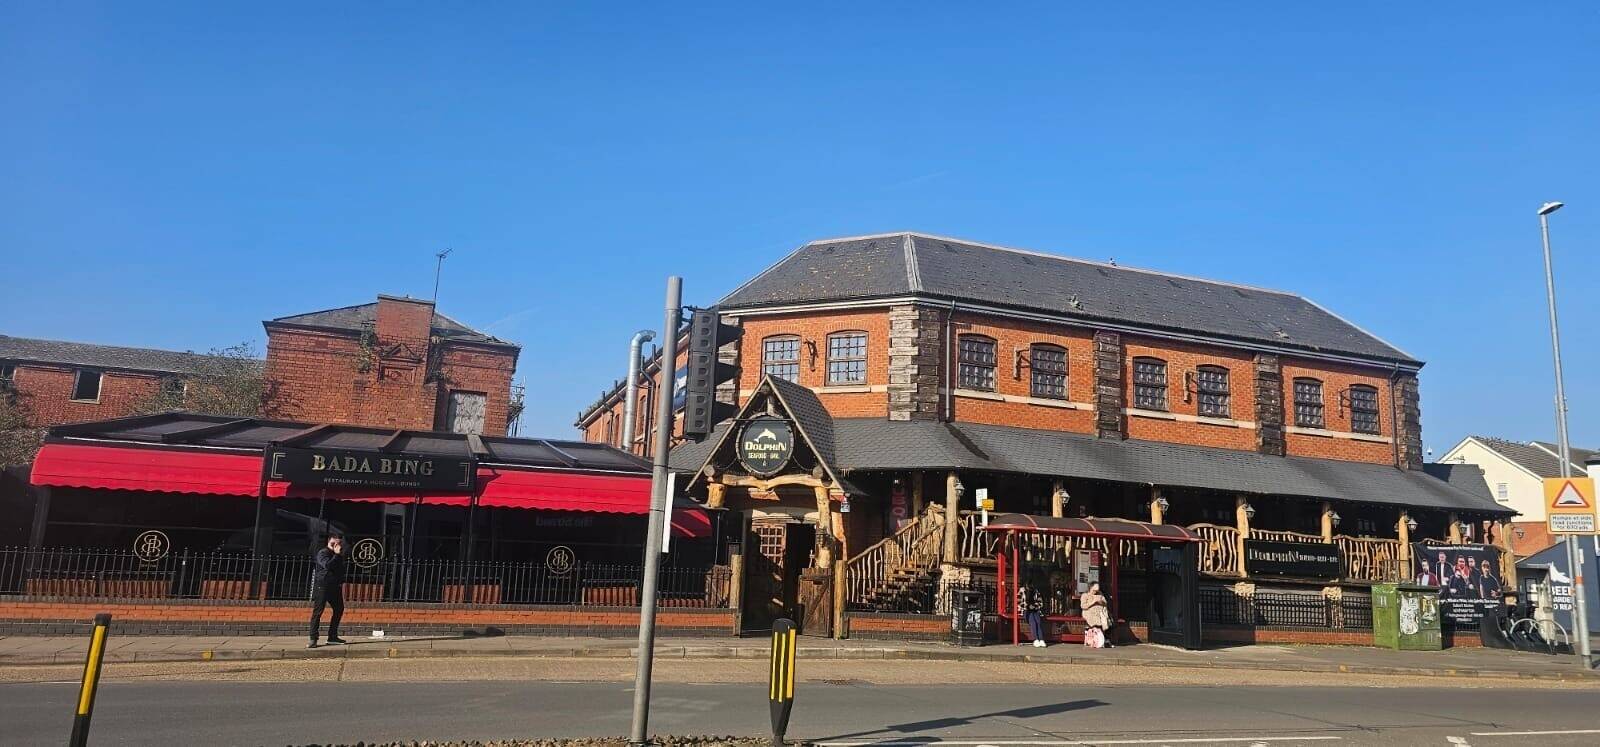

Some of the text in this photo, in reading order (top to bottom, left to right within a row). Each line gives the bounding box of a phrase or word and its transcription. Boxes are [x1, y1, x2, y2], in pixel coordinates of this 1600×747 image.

[745, 441, 787, 451] DOLPHIN
[311, 454, 435, 476] BADA BING
[323, 477, 363, 485] RESTAURANT
